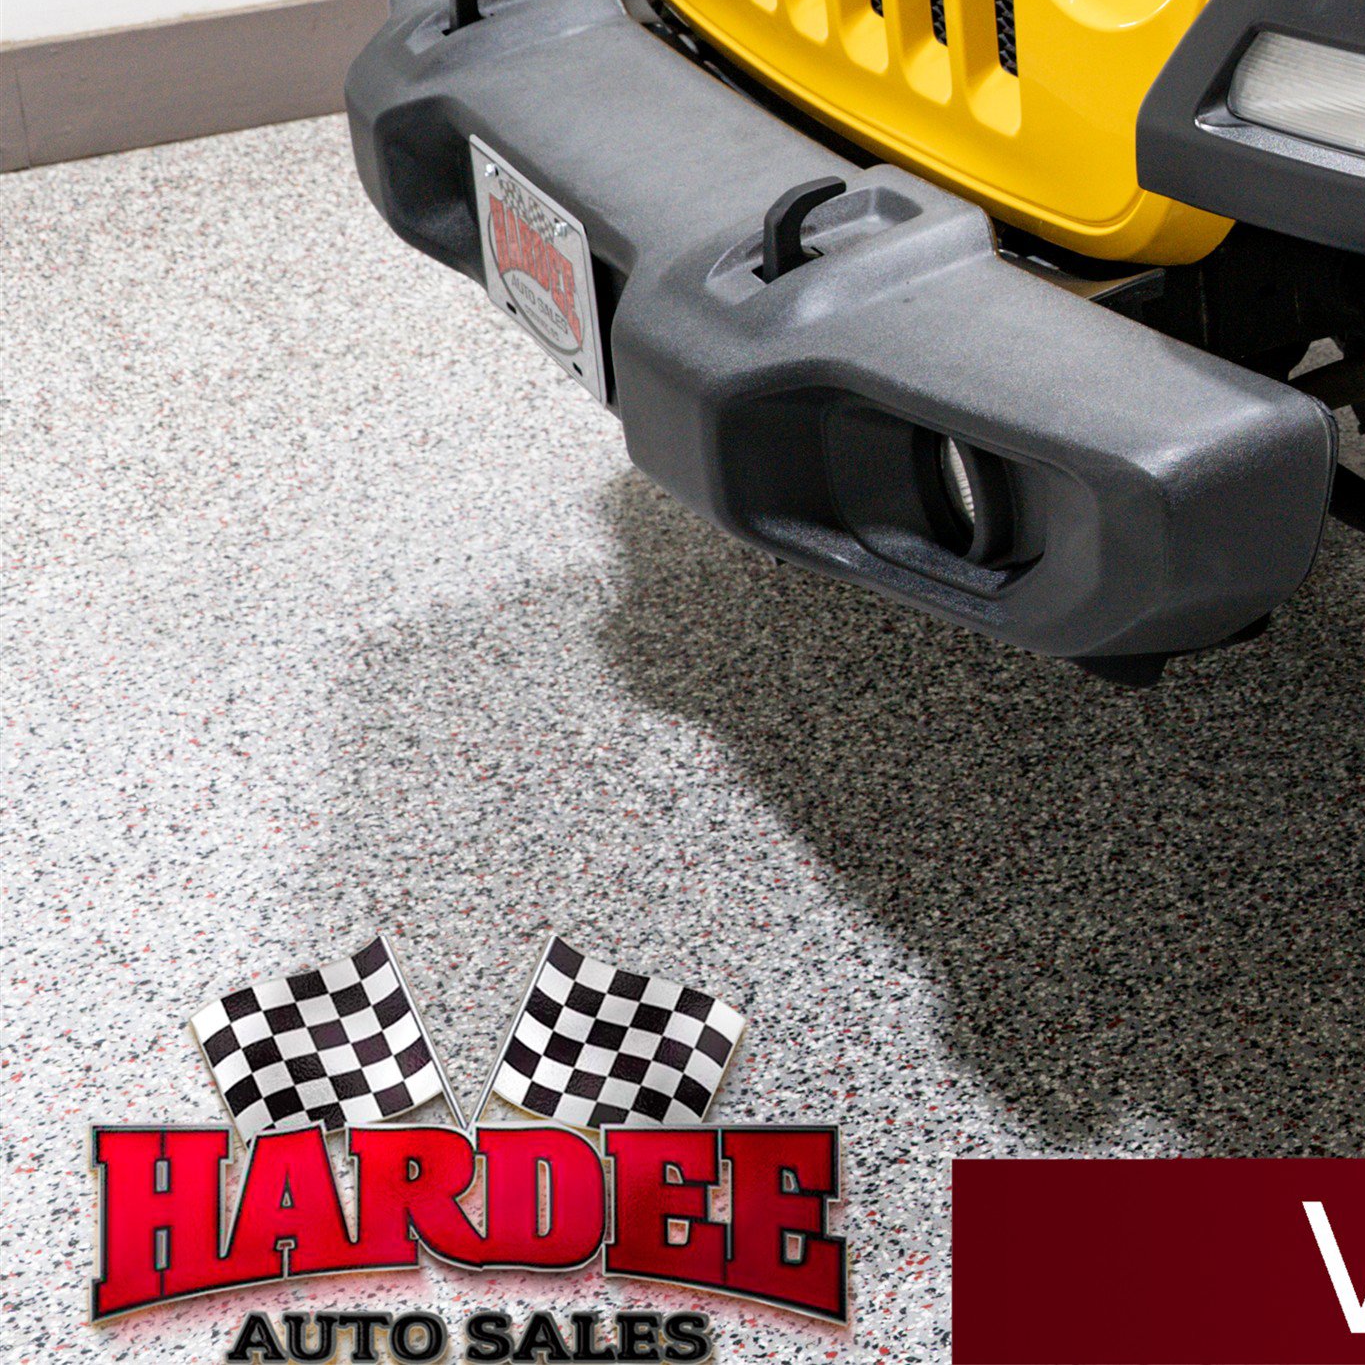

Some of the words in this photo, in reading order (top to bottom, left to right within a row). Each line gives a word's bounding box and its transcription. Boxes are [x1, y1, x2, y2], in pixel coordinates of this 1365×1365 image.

[488, 193, 582, 349] HARDEE
[511, 273, 537, 306] AUTO
[537, 296, 569, 335] SALES
